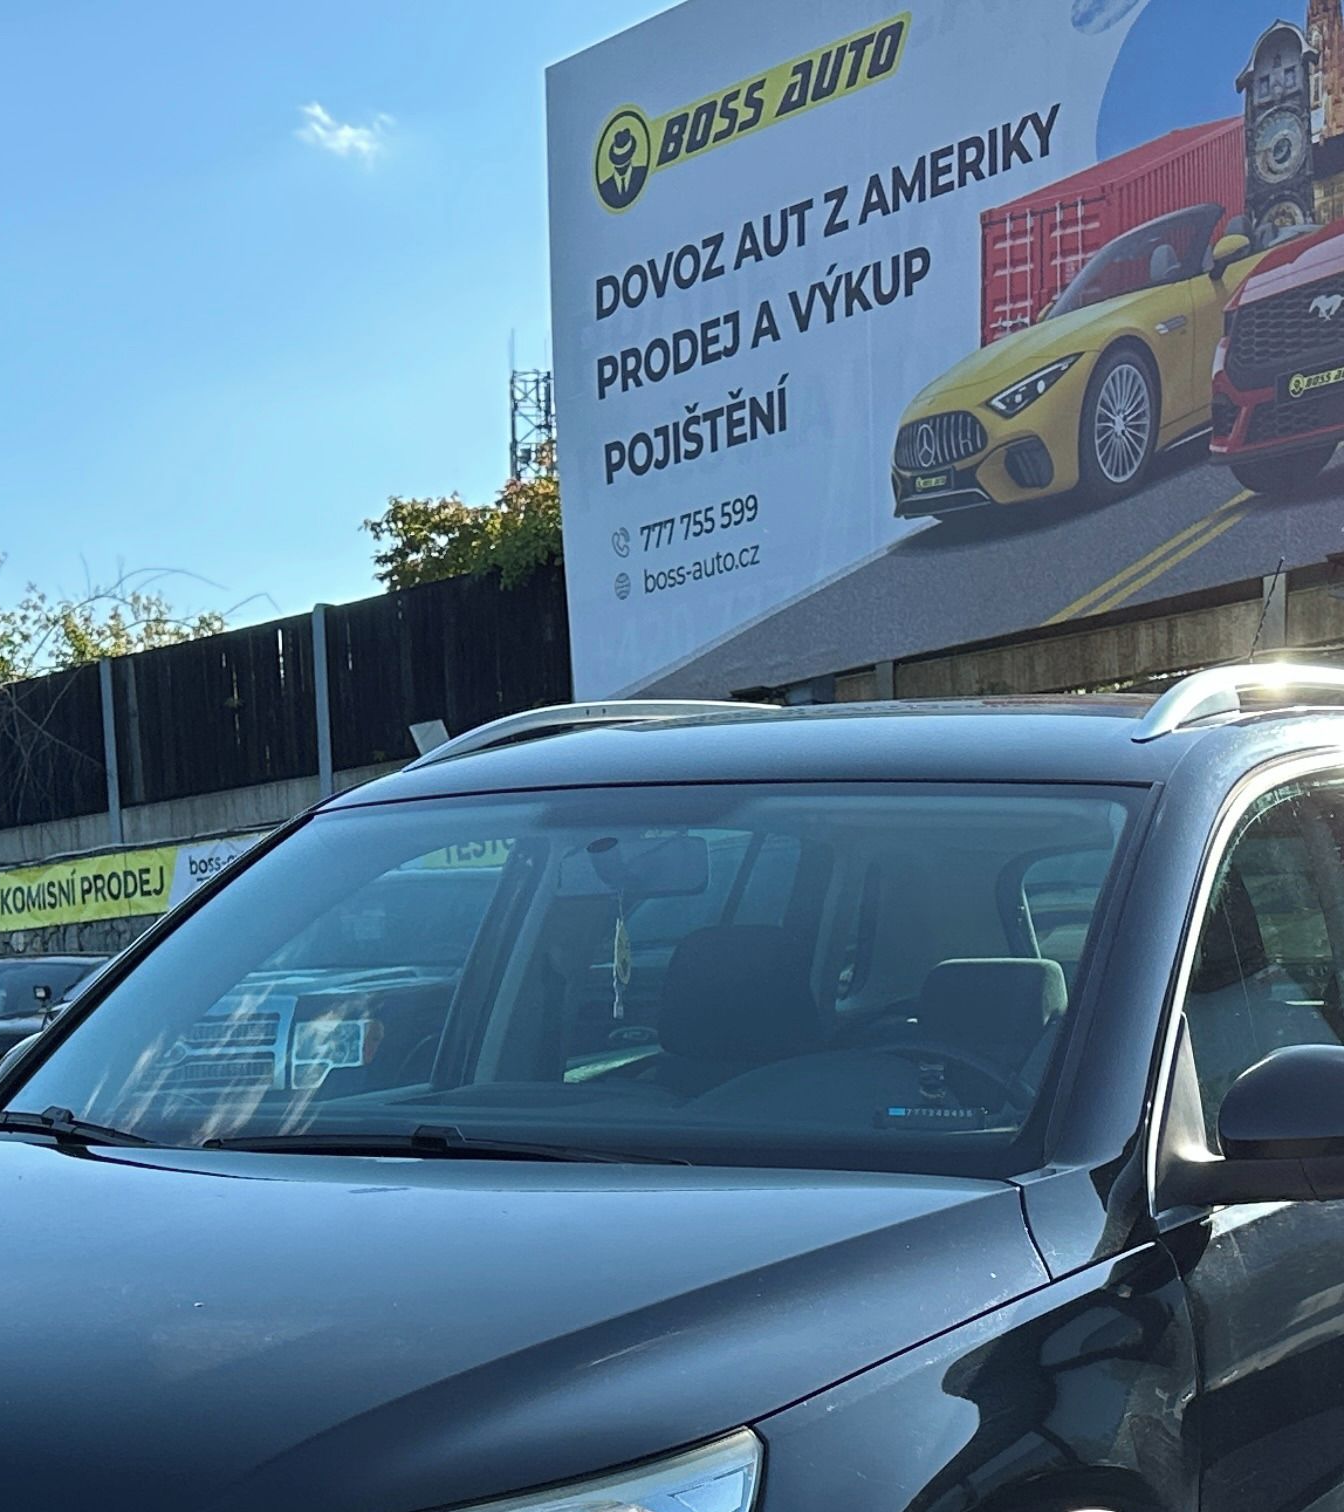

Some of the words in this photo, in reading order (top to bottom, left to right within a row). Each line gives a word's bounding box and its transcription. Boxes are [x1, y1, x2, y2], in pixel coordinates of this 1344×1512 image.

[656, 78, 766, 167] BOSS
[774, 20, 904, 118] AUTO
[595, 232, 725, 320] DOVOZ
[733, 198, 814, 272] AUT
[823, 185, 849, 235] Z
[858, 103, 1060, 226] AMERIKY
[596, 320, 740, 400] PRODEJ
[750, 301, 780, 349] A
[789, 246, 931, 334] VÝKUP
[604, 373, 790, 485] POJIŠTĚNÍ
[639, 517, 675, 552] 777
[680, 506, 715, 541] 755
[720, 494, 758, 529] 599
[643, 544, 760, 595] boss-auto.cz
[0, 869, 76, 916] KOMISNÍ
[81, 866, 165, 906] PRODEJ
